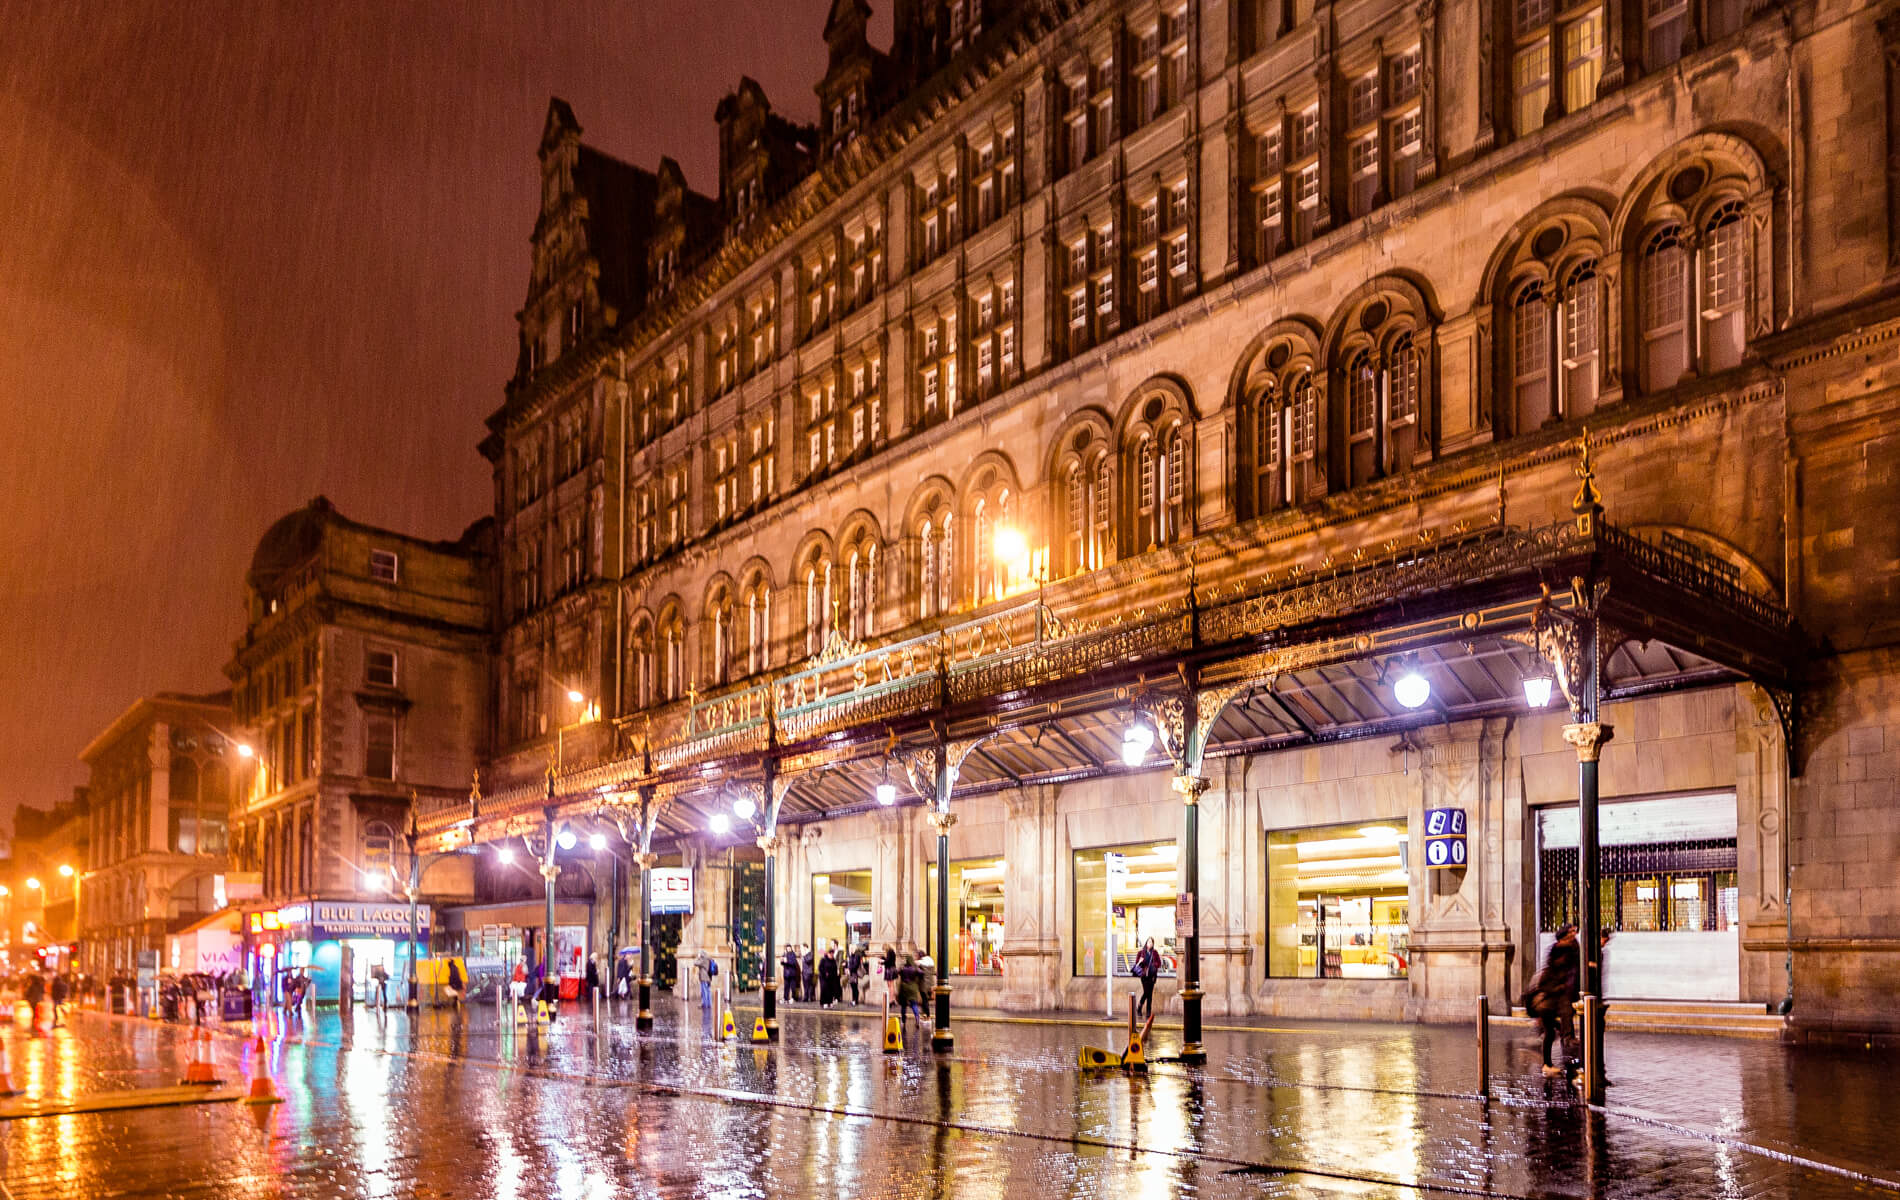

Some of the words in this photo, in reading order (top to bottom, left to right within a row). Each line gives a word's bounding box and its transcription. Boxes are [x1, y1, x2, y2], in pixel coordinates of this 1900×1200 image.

[706, 673, 828, 731] CENTRAL
[853, 614, 1013, 693] STATION
[320, 906, 357, 921] BLUE
[362, 906, 426, 922] LAGOON
[323, 924, 374, 933] TRADITIONAL
[376, 924, 393, 934] FISH
[201, 951, 230, 962] VIA
